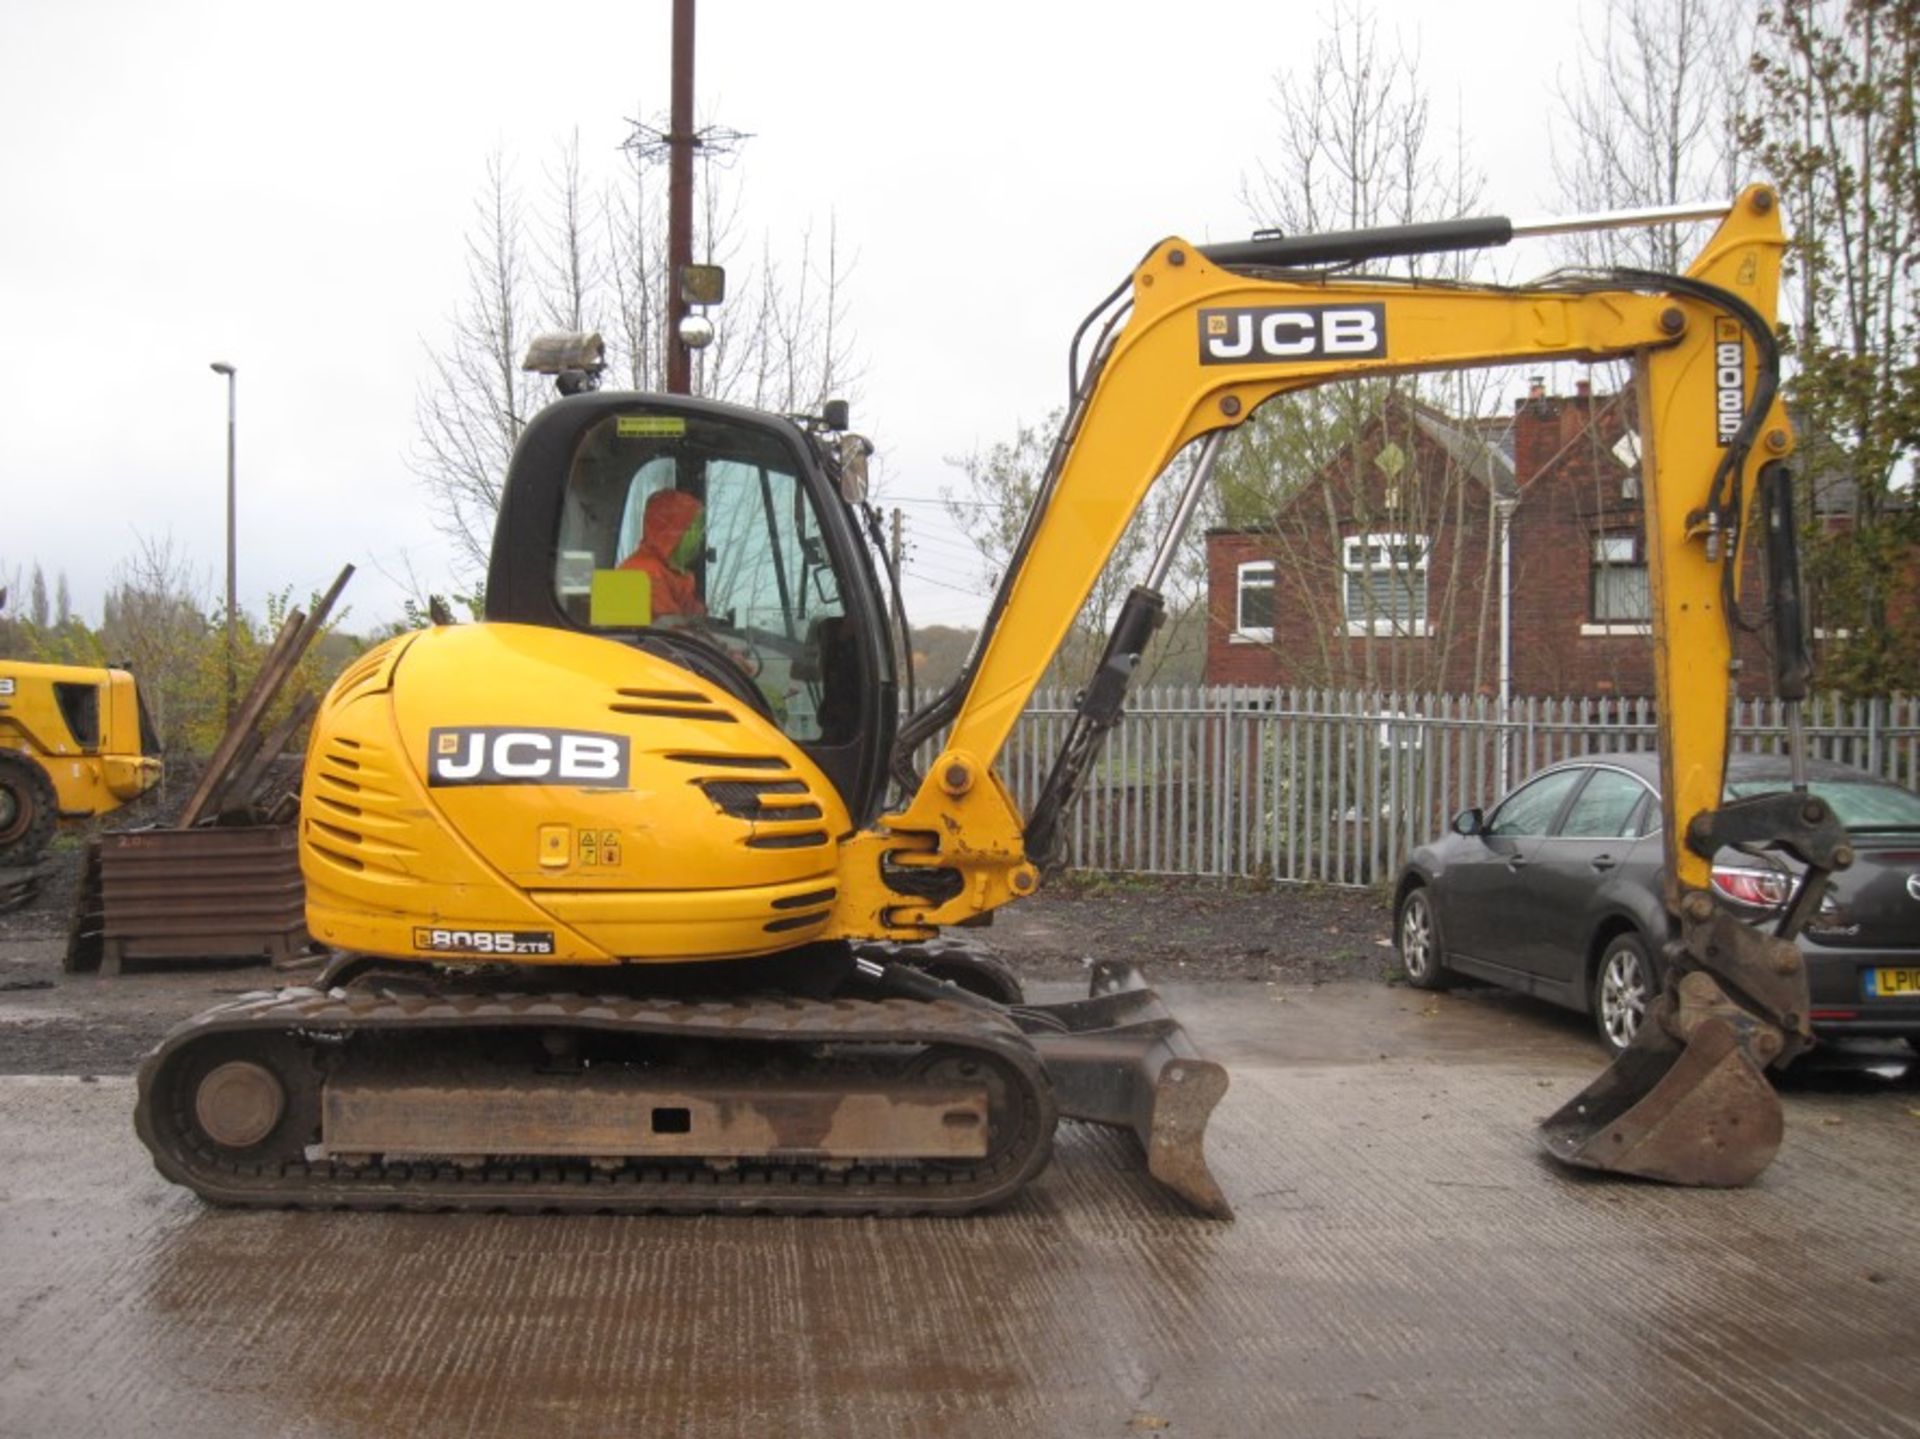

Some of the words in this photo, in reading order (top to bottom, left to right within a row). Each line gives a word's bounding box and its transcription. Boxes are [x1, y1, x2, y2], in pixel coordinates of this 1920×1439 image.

[1208, 308, 1379, 358] JCB
[437, 733, 620, 779] JCB
[432, 930, 516, 952] 8085
